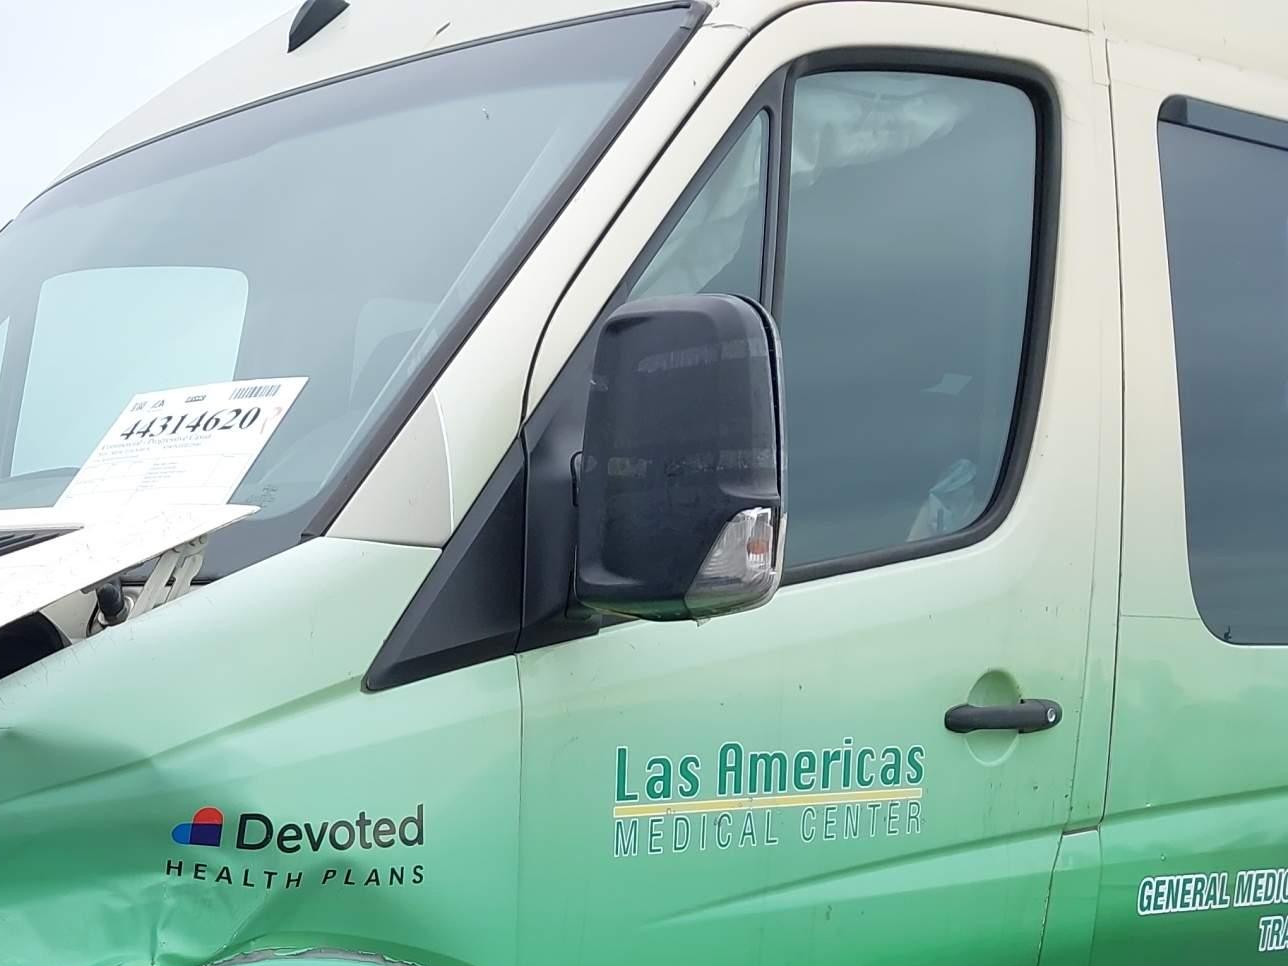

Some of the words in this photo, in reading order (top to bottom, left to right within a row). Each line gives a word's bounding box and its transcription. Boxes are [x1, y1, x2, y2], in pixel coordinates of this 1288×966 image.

[120, 406, 261, 441] 44314620
[614, 745, 701, 802] Las
[717, 737, 926, 796] Americas
[236, 803, 425, 853] Devoted
[614, 809, 779, 857] MEDICAL
[800, 799, 922, 842] CENTER
[165, 858, 304, 890] HEALTH
[321, 864, 425, 887] PLANS
[1137, 871, 1231, 916] GENERAL
